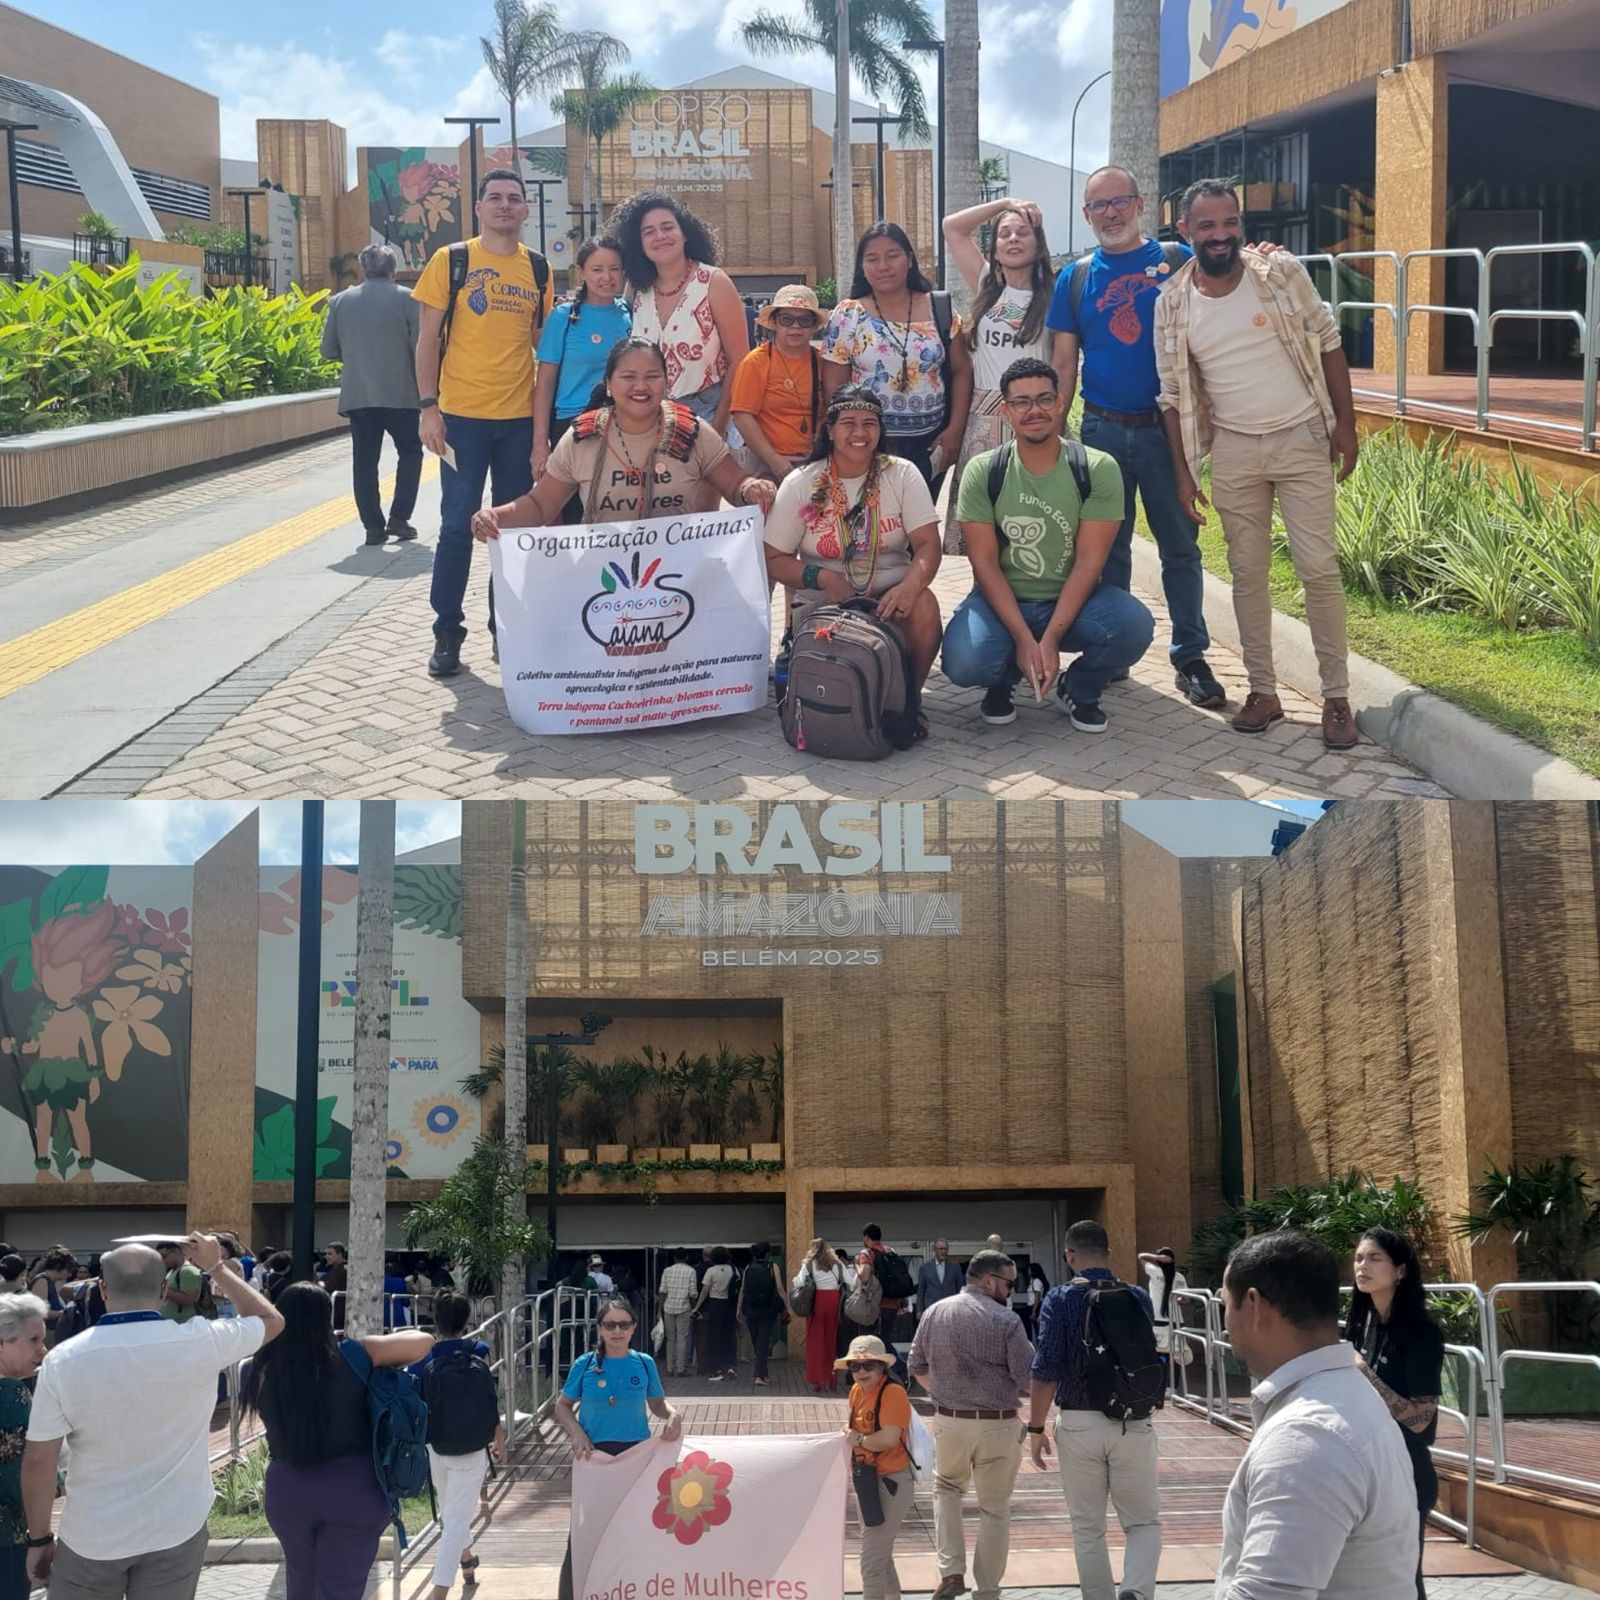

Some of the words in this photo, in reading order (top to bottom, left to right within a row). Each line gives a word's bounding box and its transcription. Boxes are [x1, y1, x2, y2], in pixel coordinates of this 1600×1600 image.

[629, 95, 750, 128] COP30
[630, 128, 750, 157] BRASIL
[696, 184, 723, 192] 2025
[600, 491, 684, 512] Árvres
[517, 526, 658, 558] Organização
[665, 517, 754, 546] Caianas
[516, 670, 553, 681] Coletivo
[553, 669, 615, 679] ambientalista
[658, 664, 671, 674] de
[672, 660, 695, 673] ação
[696, 658, 719, 670] para
[720, 653, 763, 664] natureza
[538, 701, 563, 711] Terra
[715, 683, 754, 695] cerrado
[575, 715, 623, 728] pantanal
[624, 714, 640, 724] sul
[634, 802, 952, 876] BRASIL
[640, 887, 960, 938] AMAZÔNIA
[702, 947, 798, 967] BELÉM
[808, 950, 880, 966] 2025
[645, 1572, 675, 1598] de
[684, 1571, 808, 1600] Mulheres
